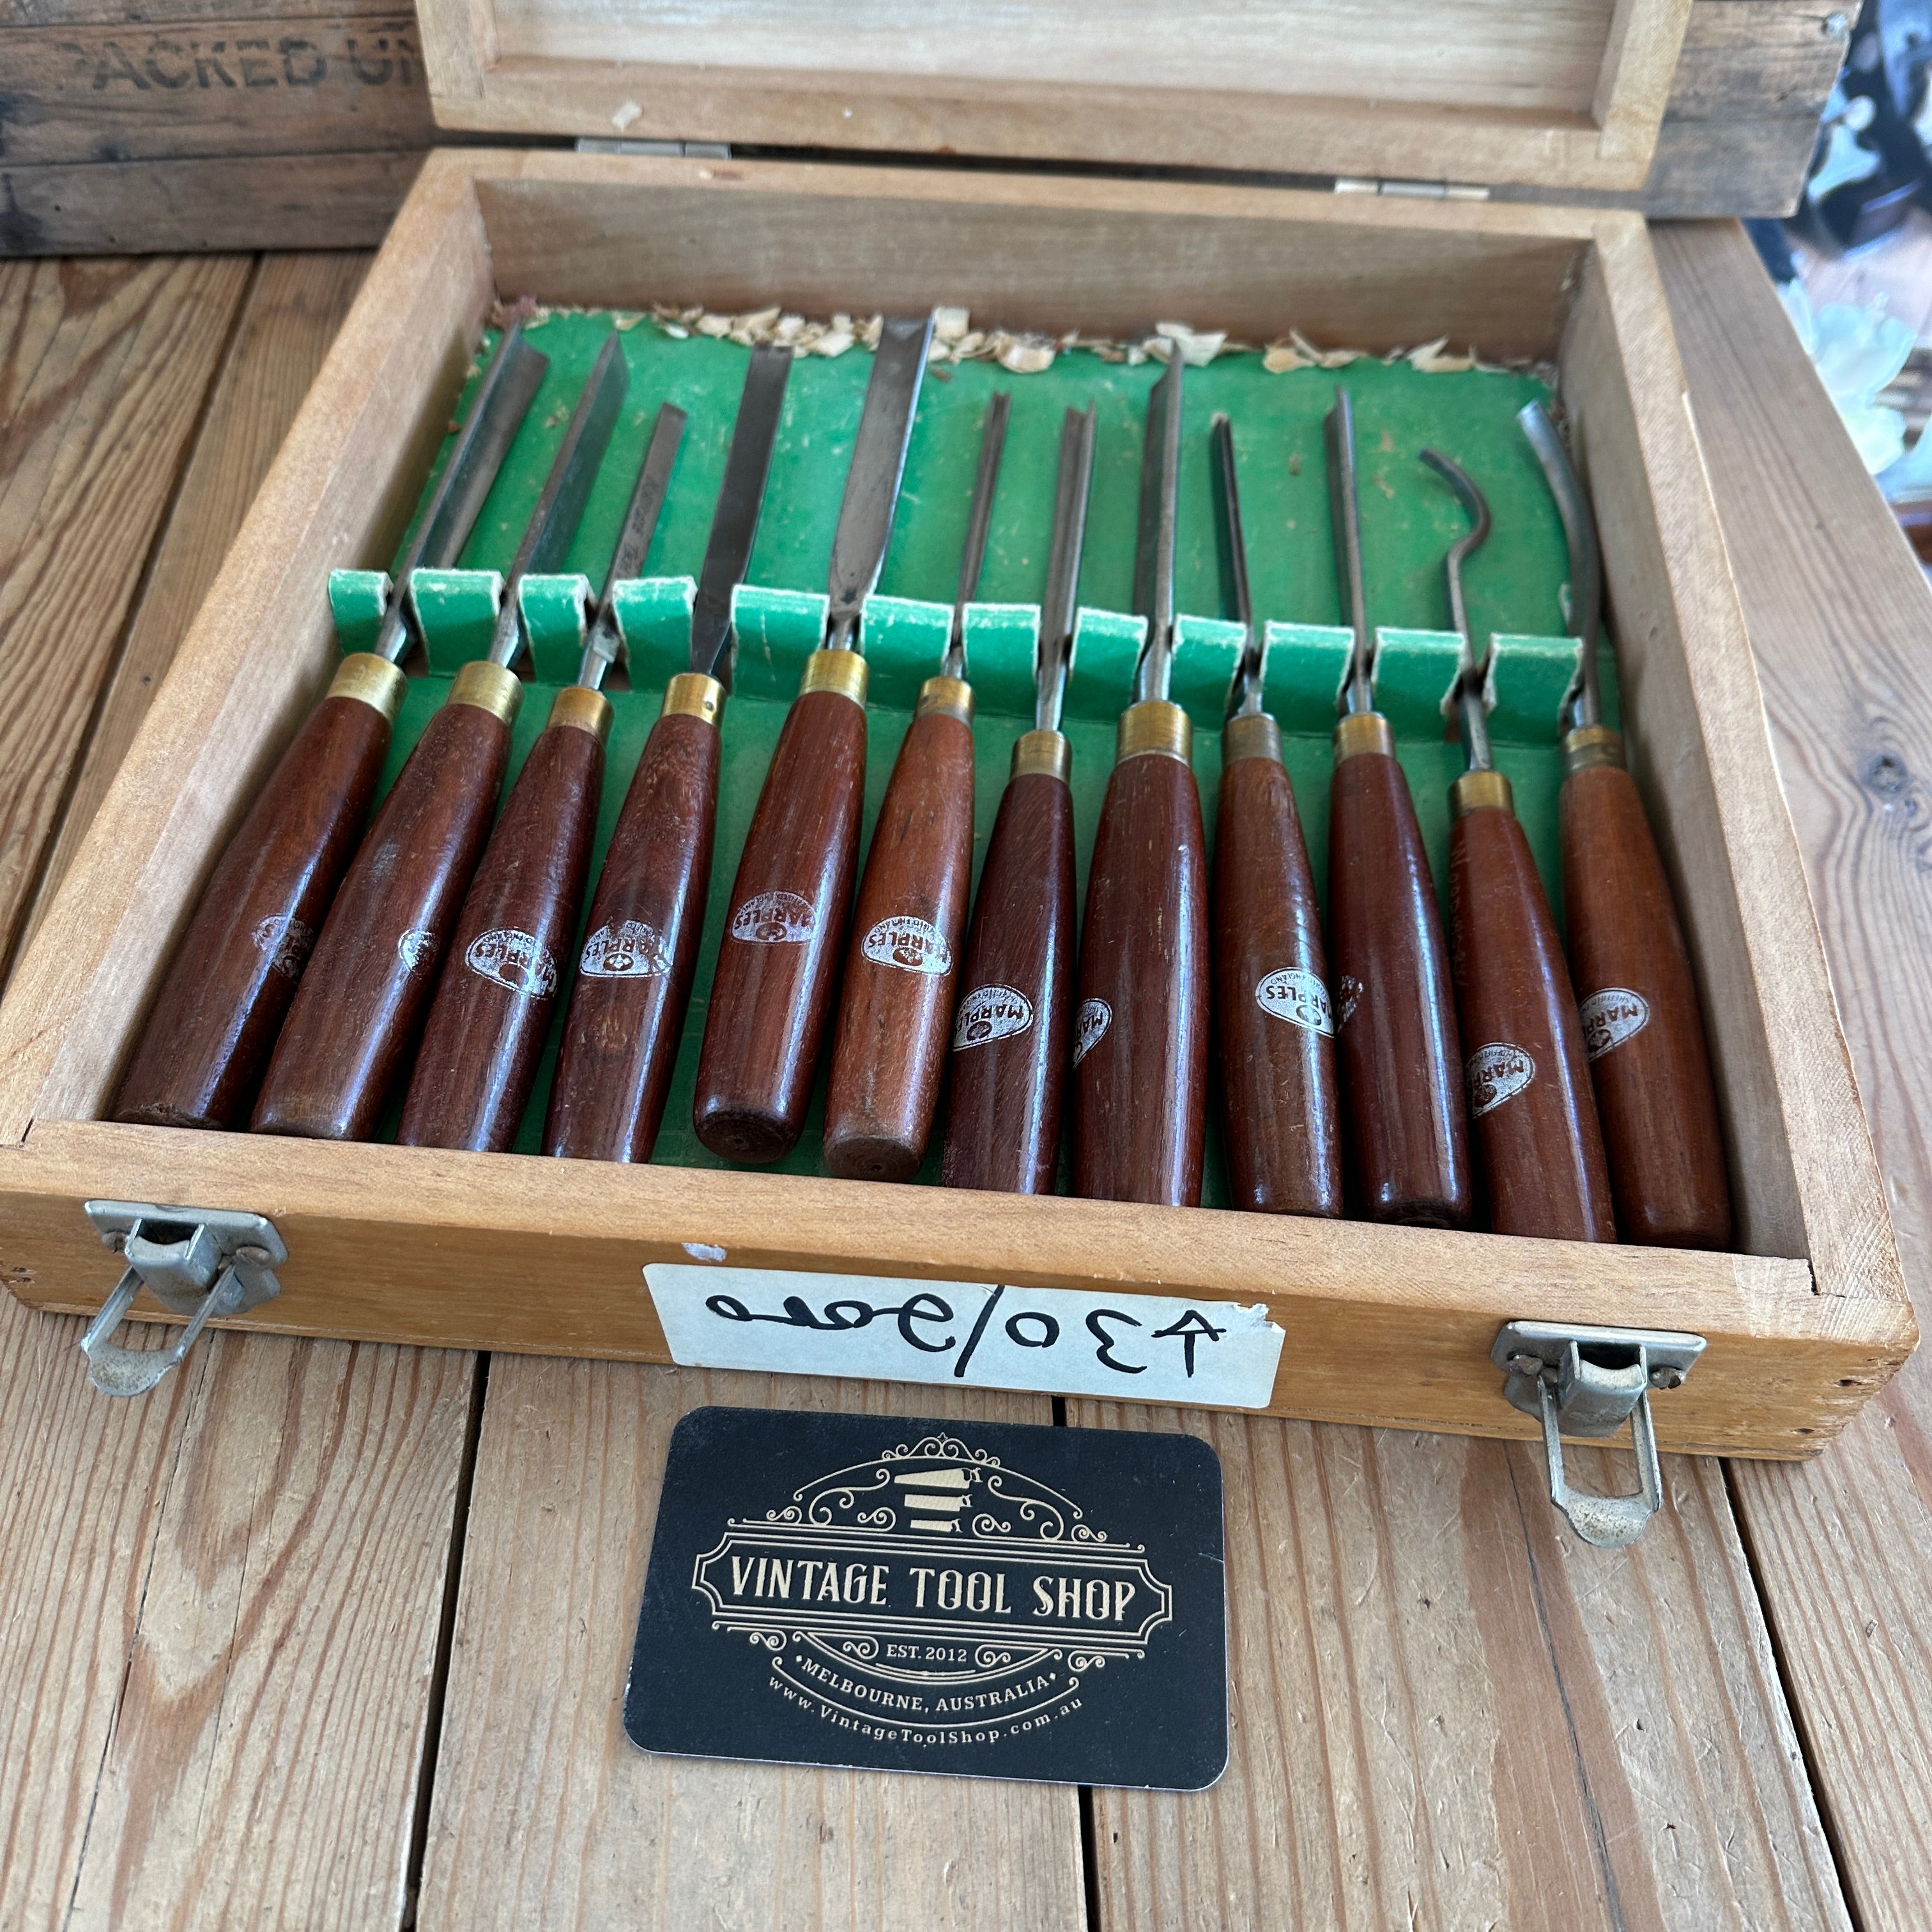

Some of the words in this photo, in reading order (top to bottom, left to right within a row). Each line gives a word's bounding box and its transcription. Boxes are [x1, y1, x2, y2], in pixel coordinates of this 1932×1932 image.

[56, 37, 326, 90] PACKED
[1266, 985, 1328, 1014] ARPLES
[1584, 1004, 1638, 1034] MARP
[730, 1555, 890, 1605] VINTAGE
[909, 1567, 1012, 1614] TOOL
[1032, 1574, 1137, 1621] SHOP
[886, 1644, 922, 1659] EST.
[925, 1646, 967, 1662] 2012
[769, 1676, 1084, 1745] www.VintageToolShop.com.au
[802, 1657, 930, 1713] MELBOURNE,
[935, 1676, 1049, 1712] AUSTRALIA
